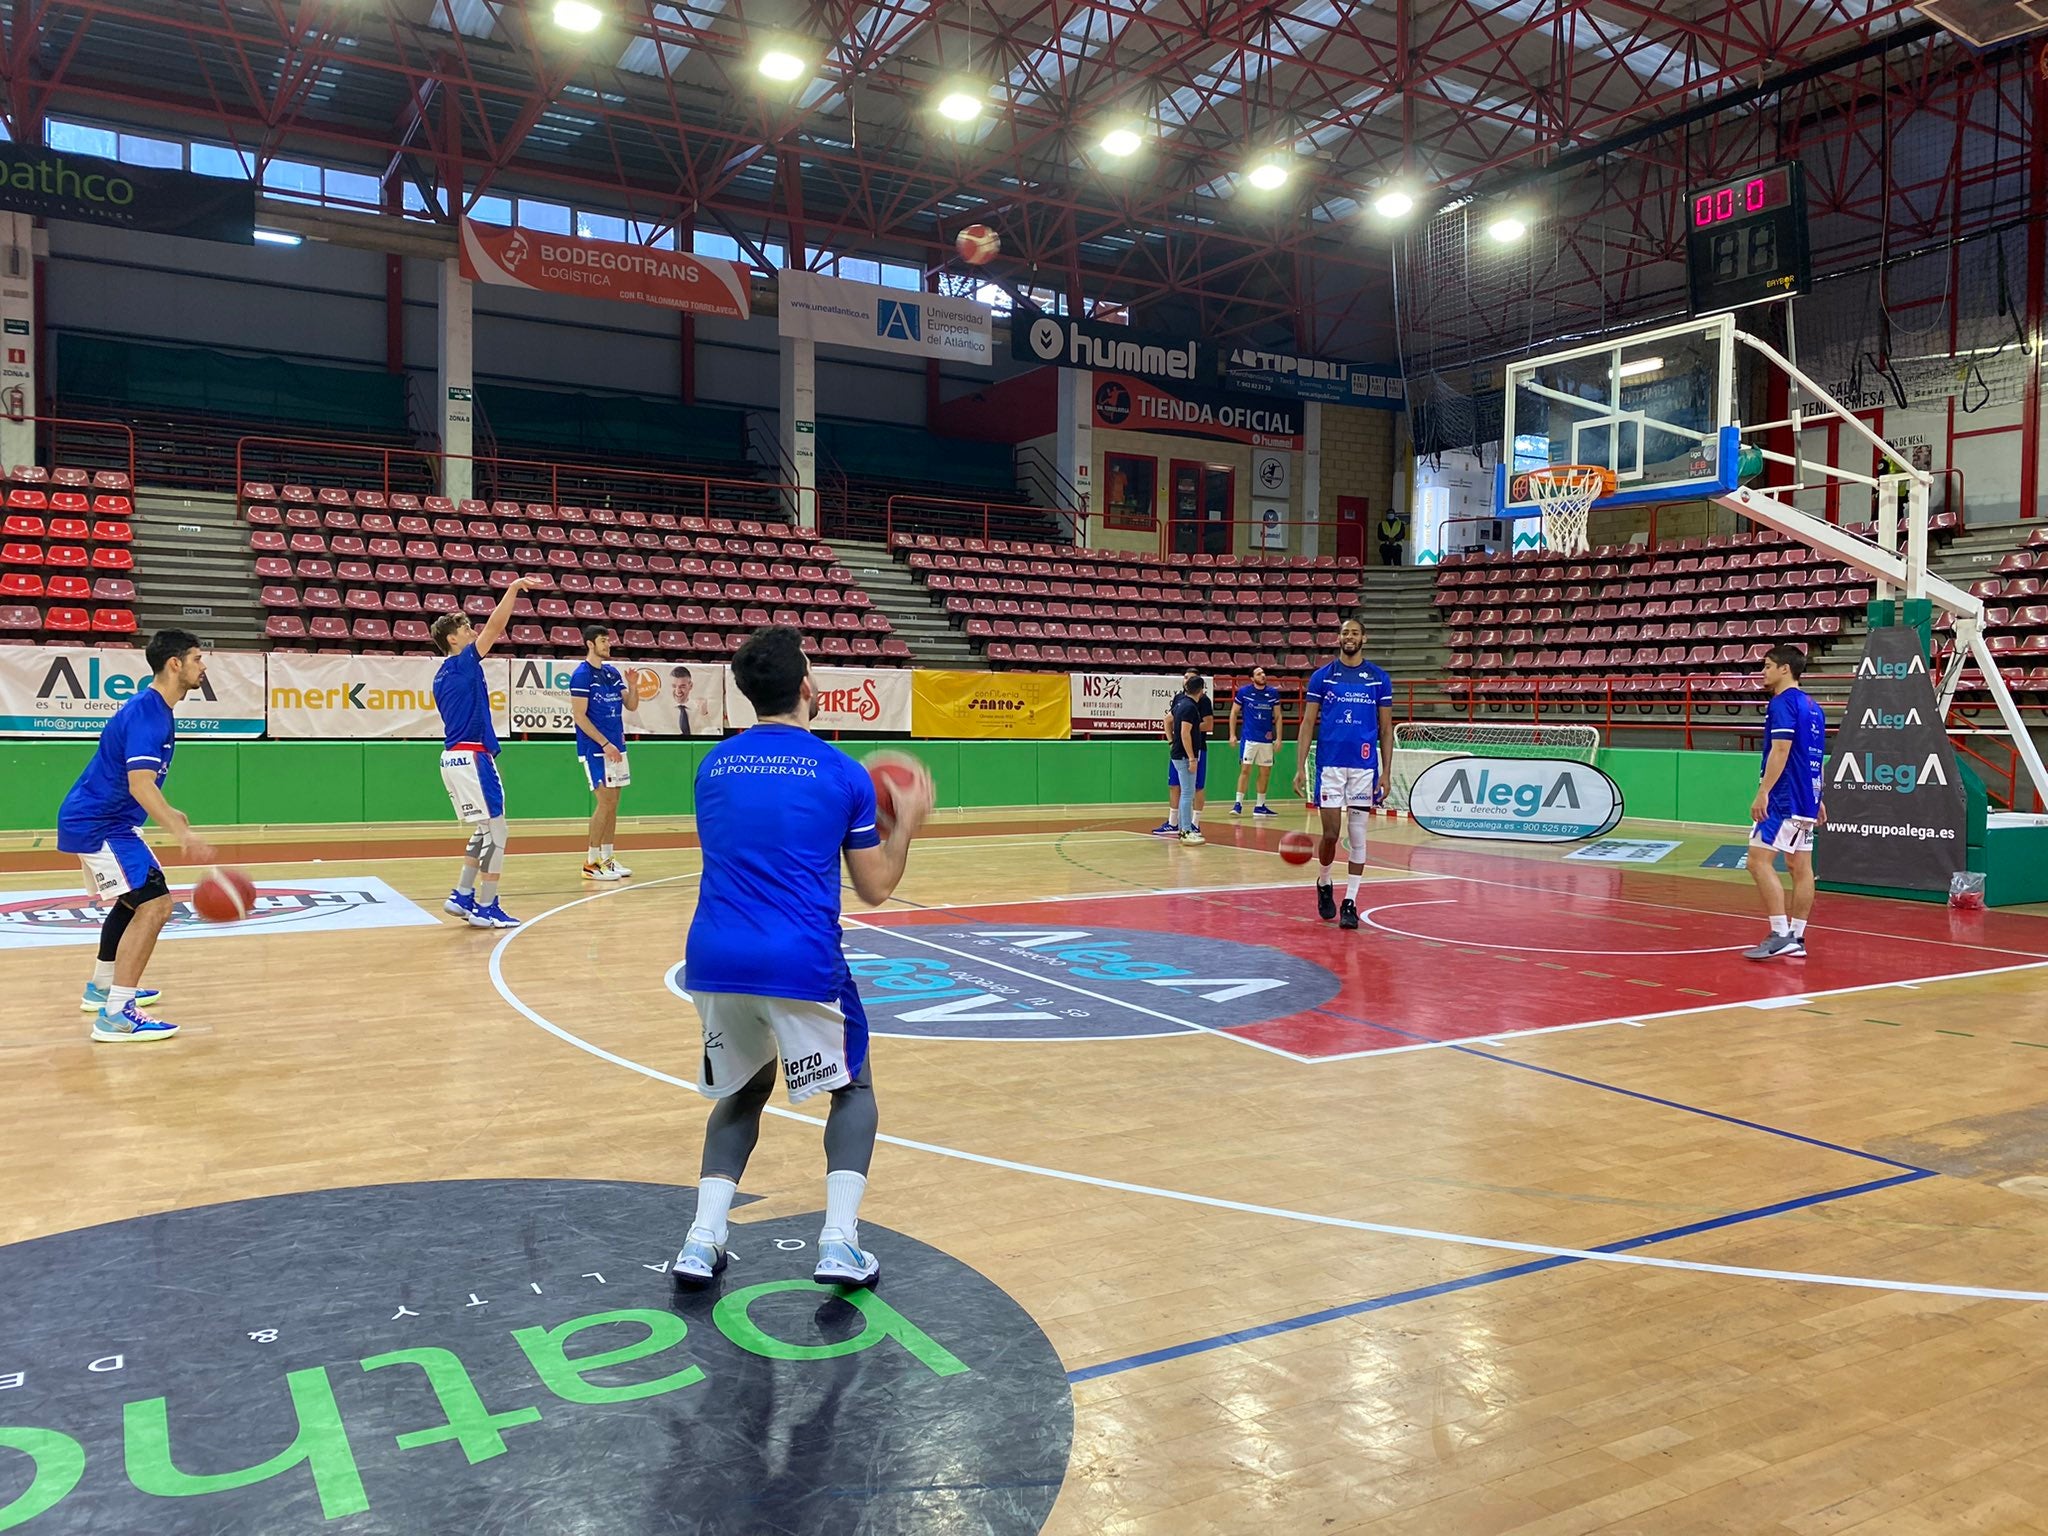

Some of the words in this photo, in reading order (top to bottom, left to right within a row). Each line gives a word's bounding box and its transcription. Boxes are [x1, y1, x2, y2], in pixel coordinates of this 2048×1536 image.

[541, 244, 699, 283] BODEGOTRANS
[619, 290, 636, 300] CON
[637, 292, 644, 301] EL
[690, 300, 738, 316] TORRELAVEGA
[790, 299, 870, 320] www.uneatlantico.es
[926, 306, 983, 325] Universidad
[927, 319, 979, 335] Europea
[927, 333, 941, 345] del
[944, 335, 985, 352] Atlántico
[1070, 321, 1196, 380] hummel
[1230, 348, 1347, 381] ARTIPUBLI
[1138, 395, 1213, 424] TIENDA
[1218, 406, 1294, 434] OFICIAL
[1262, 436, 1293, 449] hummel
[1690, 460, 1707, 471] LEB
[1858, 654, 1926, 680] AlegA
[1083, 676, 1102, 697] NS
[1152, 689, 1172, 698] FISCAL
[36, 702, 49, 710] es
[61, 702, 73, 710] tu
[513, 705, 557, 715] CONSULTA
[559, 706, 571, 715] TU
[178, 719, 199, 730] 525
[200, 720, 220, 730] 672
[514, 714, 547, 729] 900
[1860, 707, 1922, 730] AlegA
[714, 754, 818, 767] AYUNTAMIENTO
[1361, 743, 1371, 759] 6
[710, 766, 725, 778] DE
[726, 765, 817, 778] PONFERRADA
[1833, 752, 1947, 793] AlegA
[1437, 768, 1581, 817] AlegA
[1862, 783, 1892, 792] derecho
[1435, 805, 1446, 813] es
[1453, 805, 1463, 813] tu
[1470, 805, 1507, 815] derecho
[1431, 818, 1515, 830] info@grupoalega.es
[1522, 822, 1540, 832] 900
[1541, 823, 1559, 833] 525
[1561, 824, 1579, 834] 672
[1826, 821, 1955, 840] www.grupoalega.es
[783, 1052, 822, 1076] ierzo
